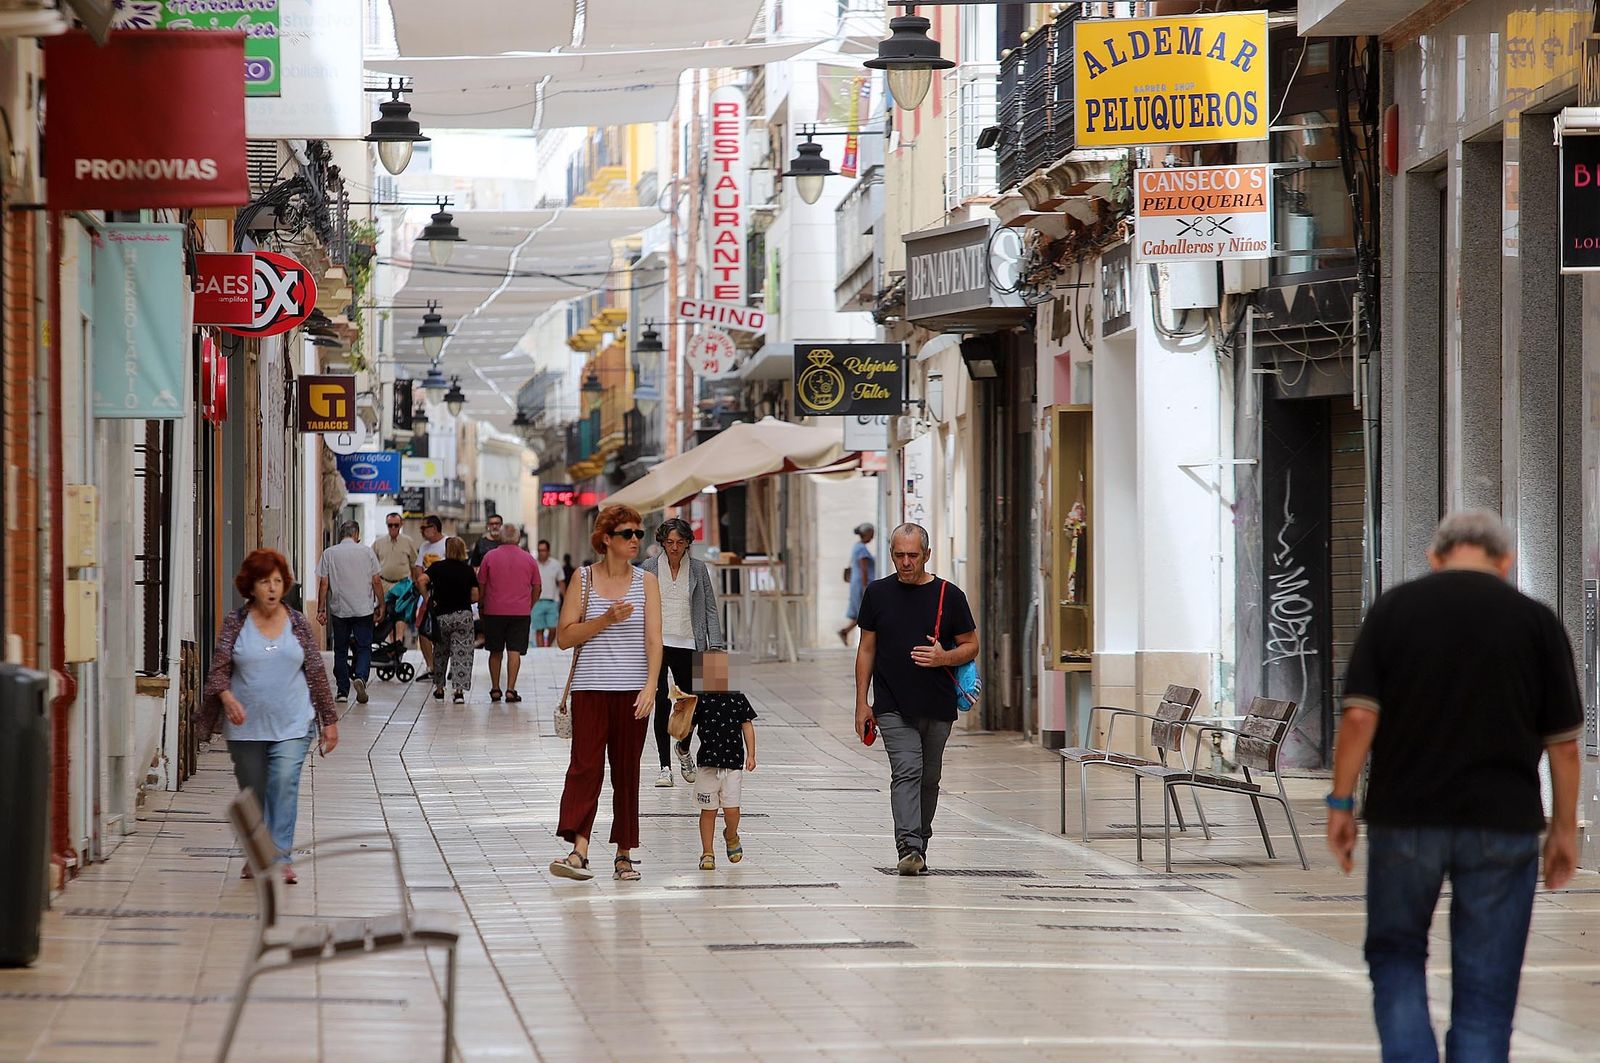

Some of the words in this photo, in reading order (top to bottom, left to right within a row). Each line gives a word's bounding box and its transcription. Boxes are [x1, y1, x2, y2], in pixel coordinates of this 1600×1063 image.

[1083, 26, 1258, 79] ALDEMAR
[1086, 91, 1258, 132] PELUQUEROS
[75, 159, 218, 180] PRONOVIAS
[713, 103, 740, 300] RESTAURANTE
[1142, 193, 1264, 211] PELUQUERIA
[1143, 239, 1213, 256] Caballeros
[1216, 243, 1226, 256] y
[1229, 237, 1267, 252] Niños
[911, 243, 985, 301] BENAVENTE
[195, 275, 249, 294] GAES
[218, 295, 249, 303] amplifon
[680, 301, 764, 329] CHINO
[843, 356, 899, 379] Relojería
[851, 382, 891, 400] Taller
[307, 421, 349, 430] TABACOS
